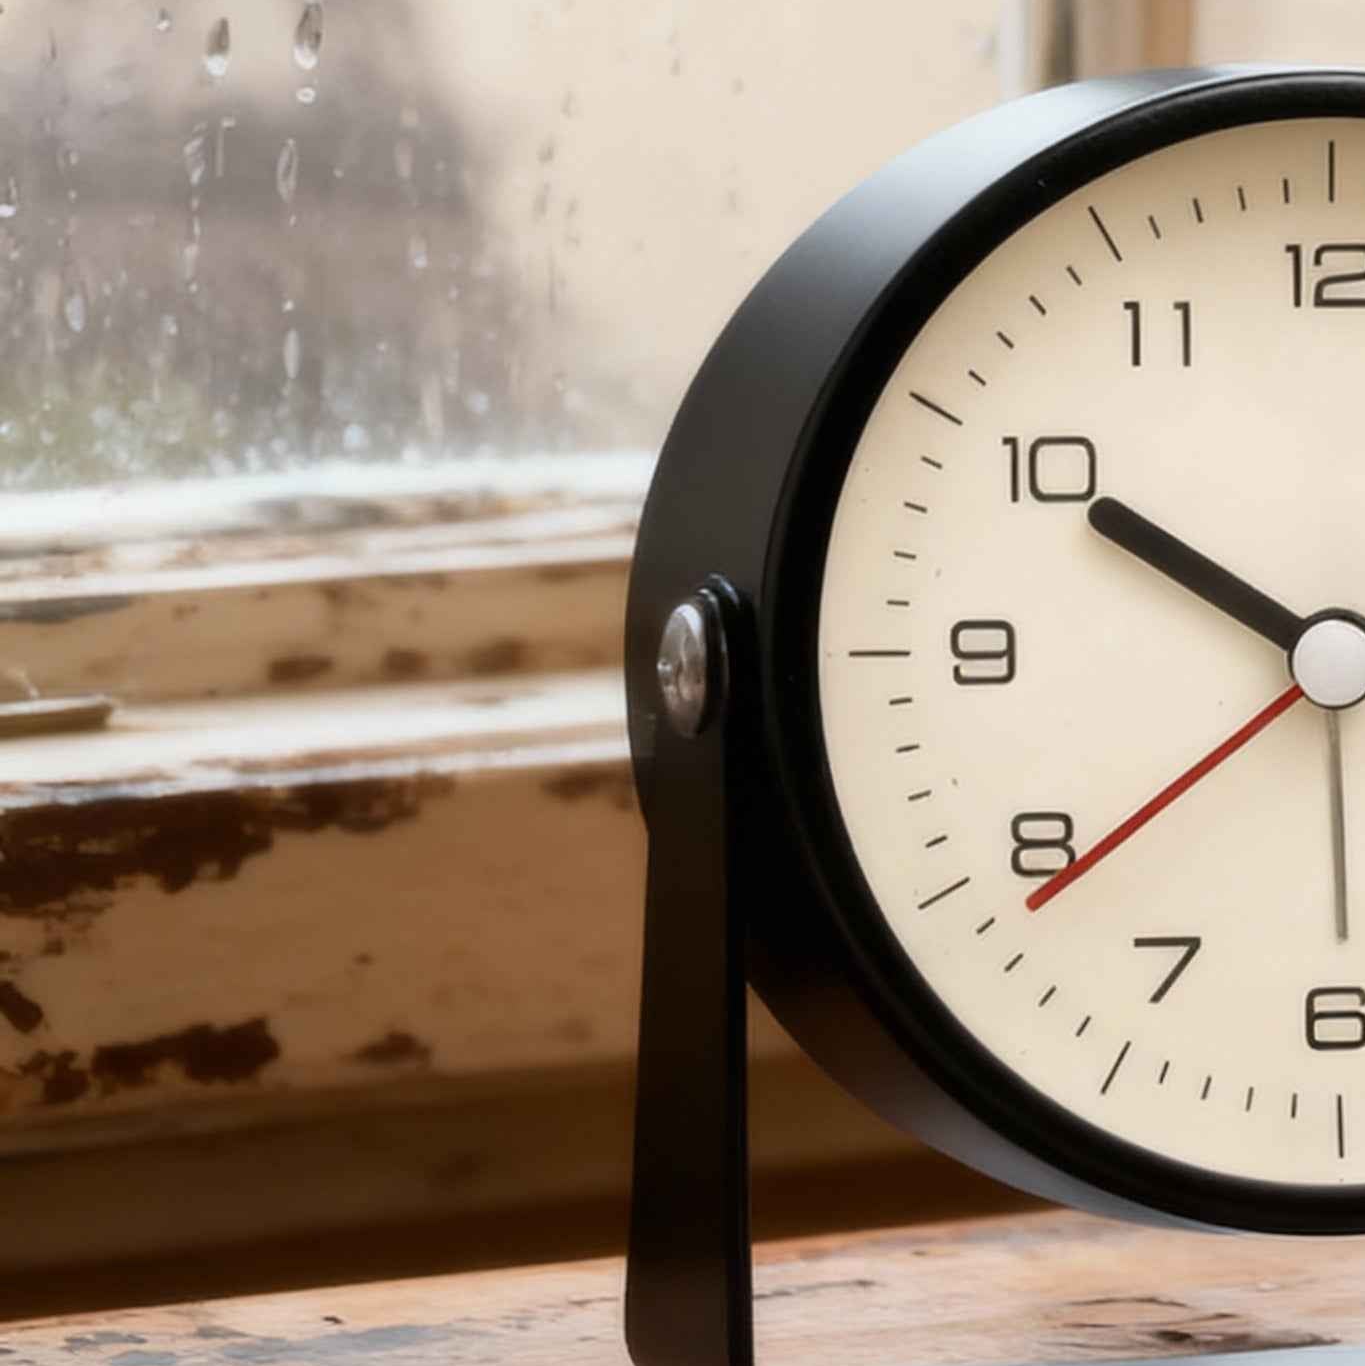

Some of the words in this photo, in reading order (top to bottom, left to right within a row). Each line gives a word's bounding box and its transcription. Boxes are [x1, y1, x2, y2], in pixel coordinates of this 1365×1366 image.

[1123, 300, 1192, 367] 11
[1002, 436, 1096, 502] 10
[950, 620, 1016, 686] 9
[1011, 812, 1075, 878] 8
[1134, 936, 1202, 1003] 7
